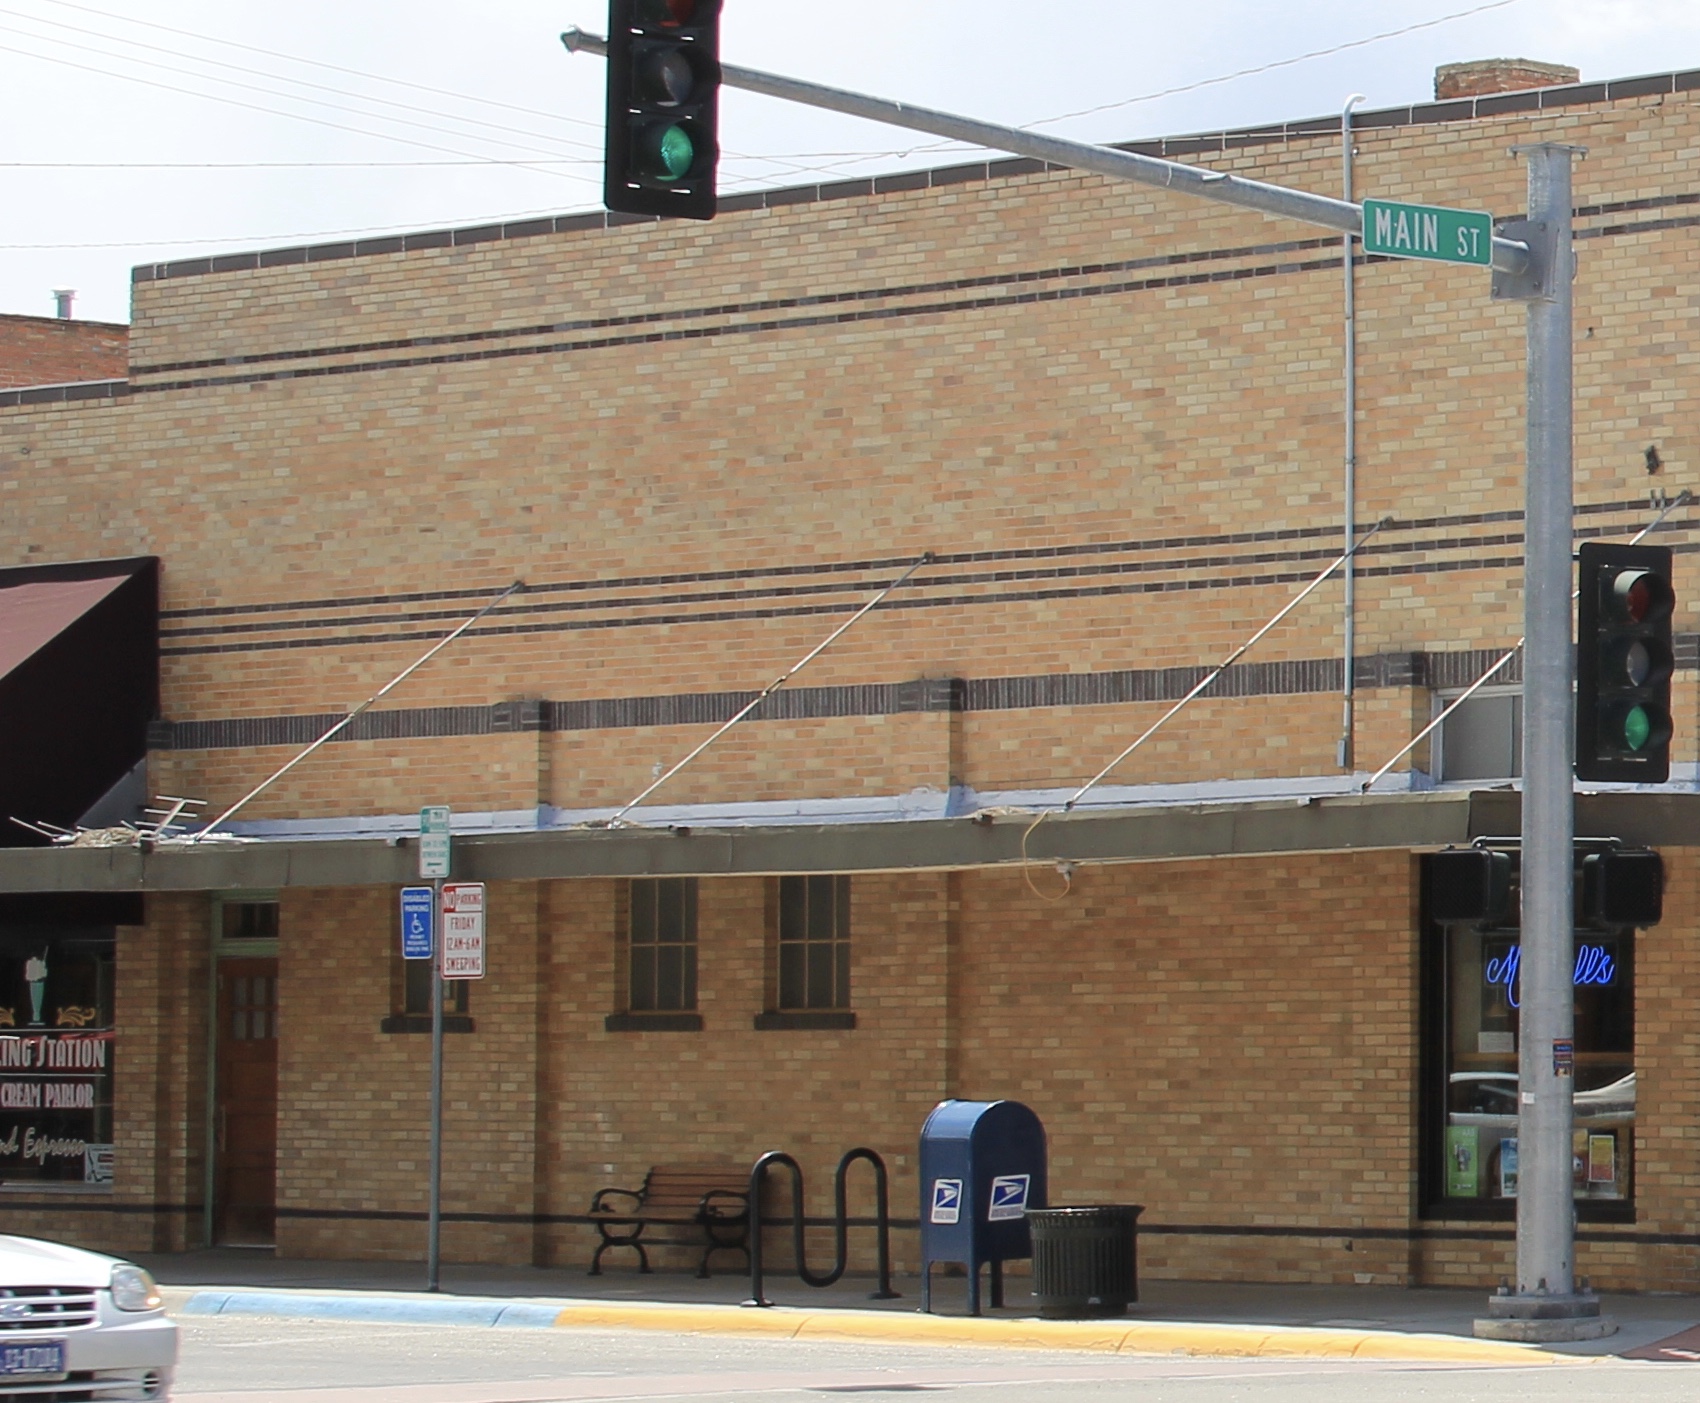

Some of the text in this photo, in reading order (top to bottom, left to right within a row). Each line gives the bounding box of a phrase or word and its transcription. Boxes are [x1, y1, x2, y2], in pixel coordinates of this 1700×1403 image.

[1375, 206, 1480, 258] MAIN ST
[443, 890, 482, 909] NO PARKING
[451, 916, 475, 930] FRIDAY
[446, 956, 480, 970] SWEEPING
[0, 1035, 106, 1068] ING STATION
[1, 1082, 94, 1108] CREAM PARLOR
